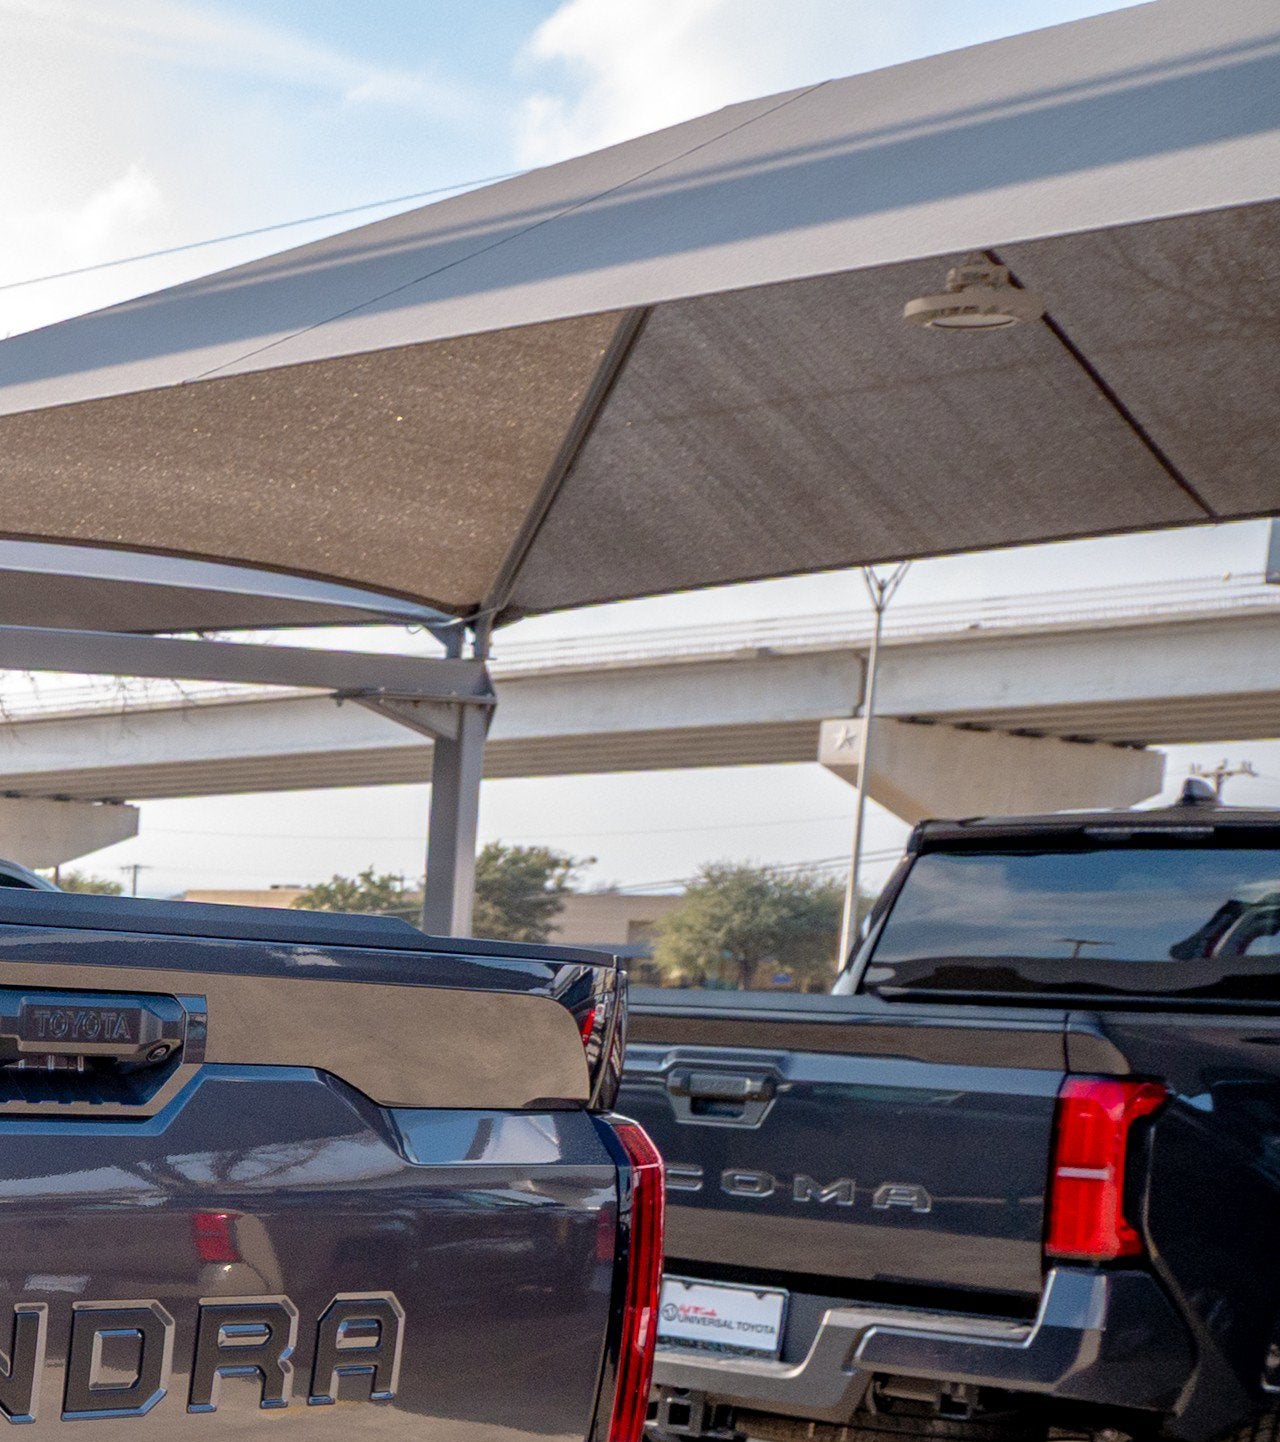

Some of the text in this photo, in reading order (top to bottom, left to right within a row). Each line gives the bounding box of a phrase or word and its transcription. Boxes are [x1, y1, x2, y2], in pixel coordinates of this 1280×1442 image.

[33, 1010, 132, 1040] TOYOTA
[664, 1163, 933, 1213] COMA
[678, 1314, 776, 1334] UNIVERSAL TOYOTA
